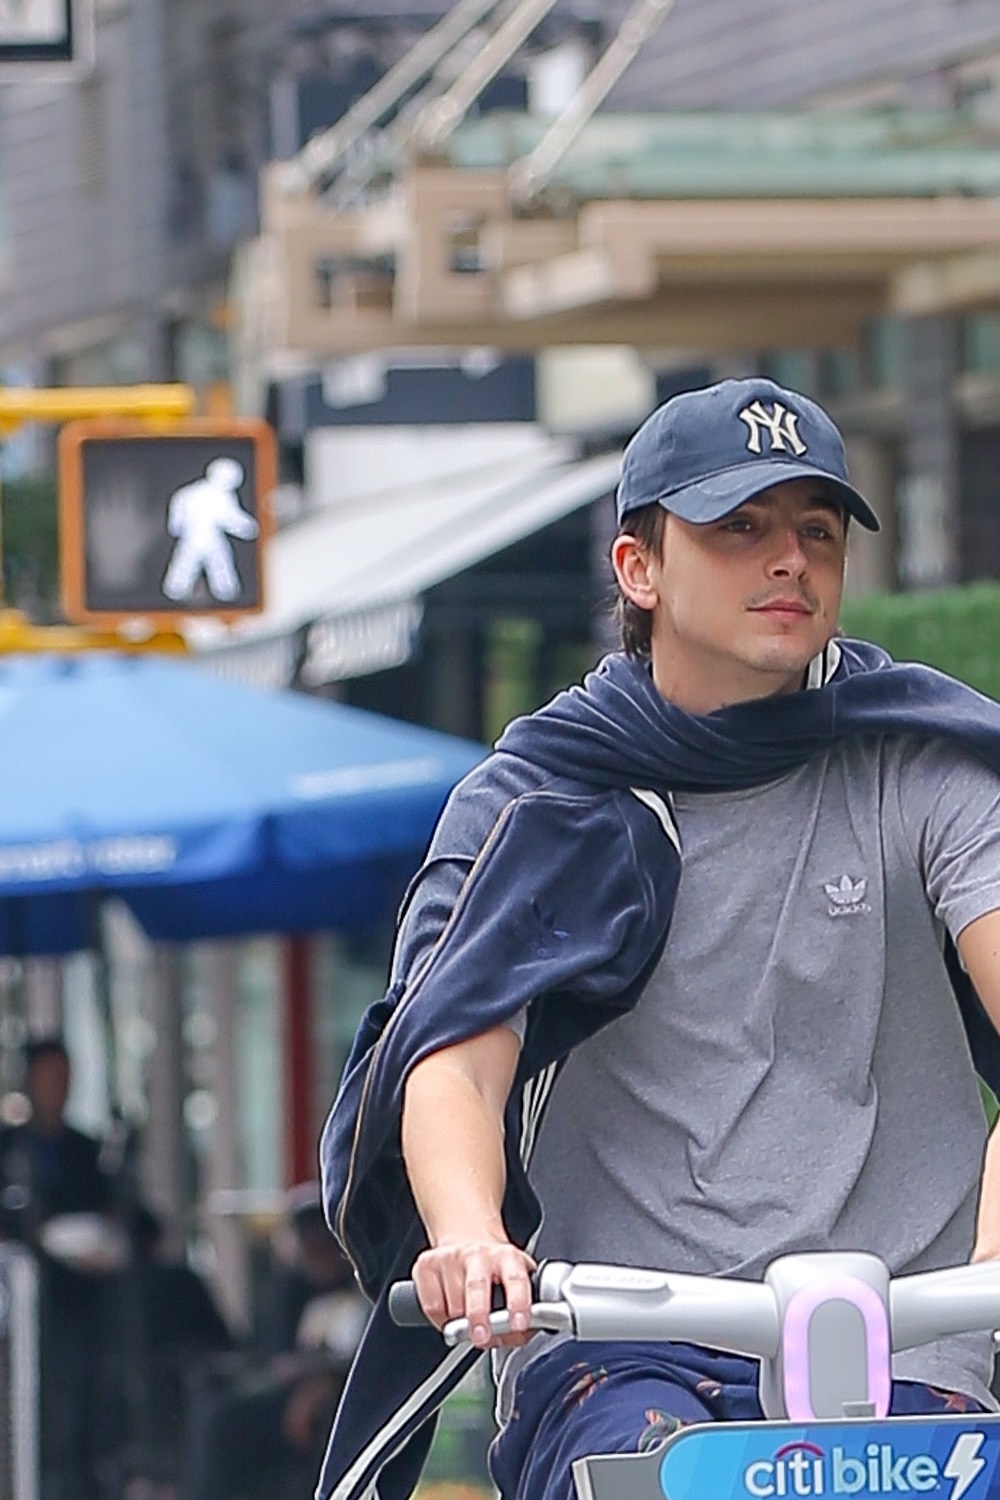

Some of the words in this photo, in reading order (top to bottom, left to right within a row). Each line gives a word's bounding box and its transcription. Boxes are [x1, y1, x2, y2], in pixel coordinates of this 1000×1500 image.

[739, 400, 807, 455] NY
[744, 1441, 825, 1497] citi
[832, 1443, 939, 1493] bike
